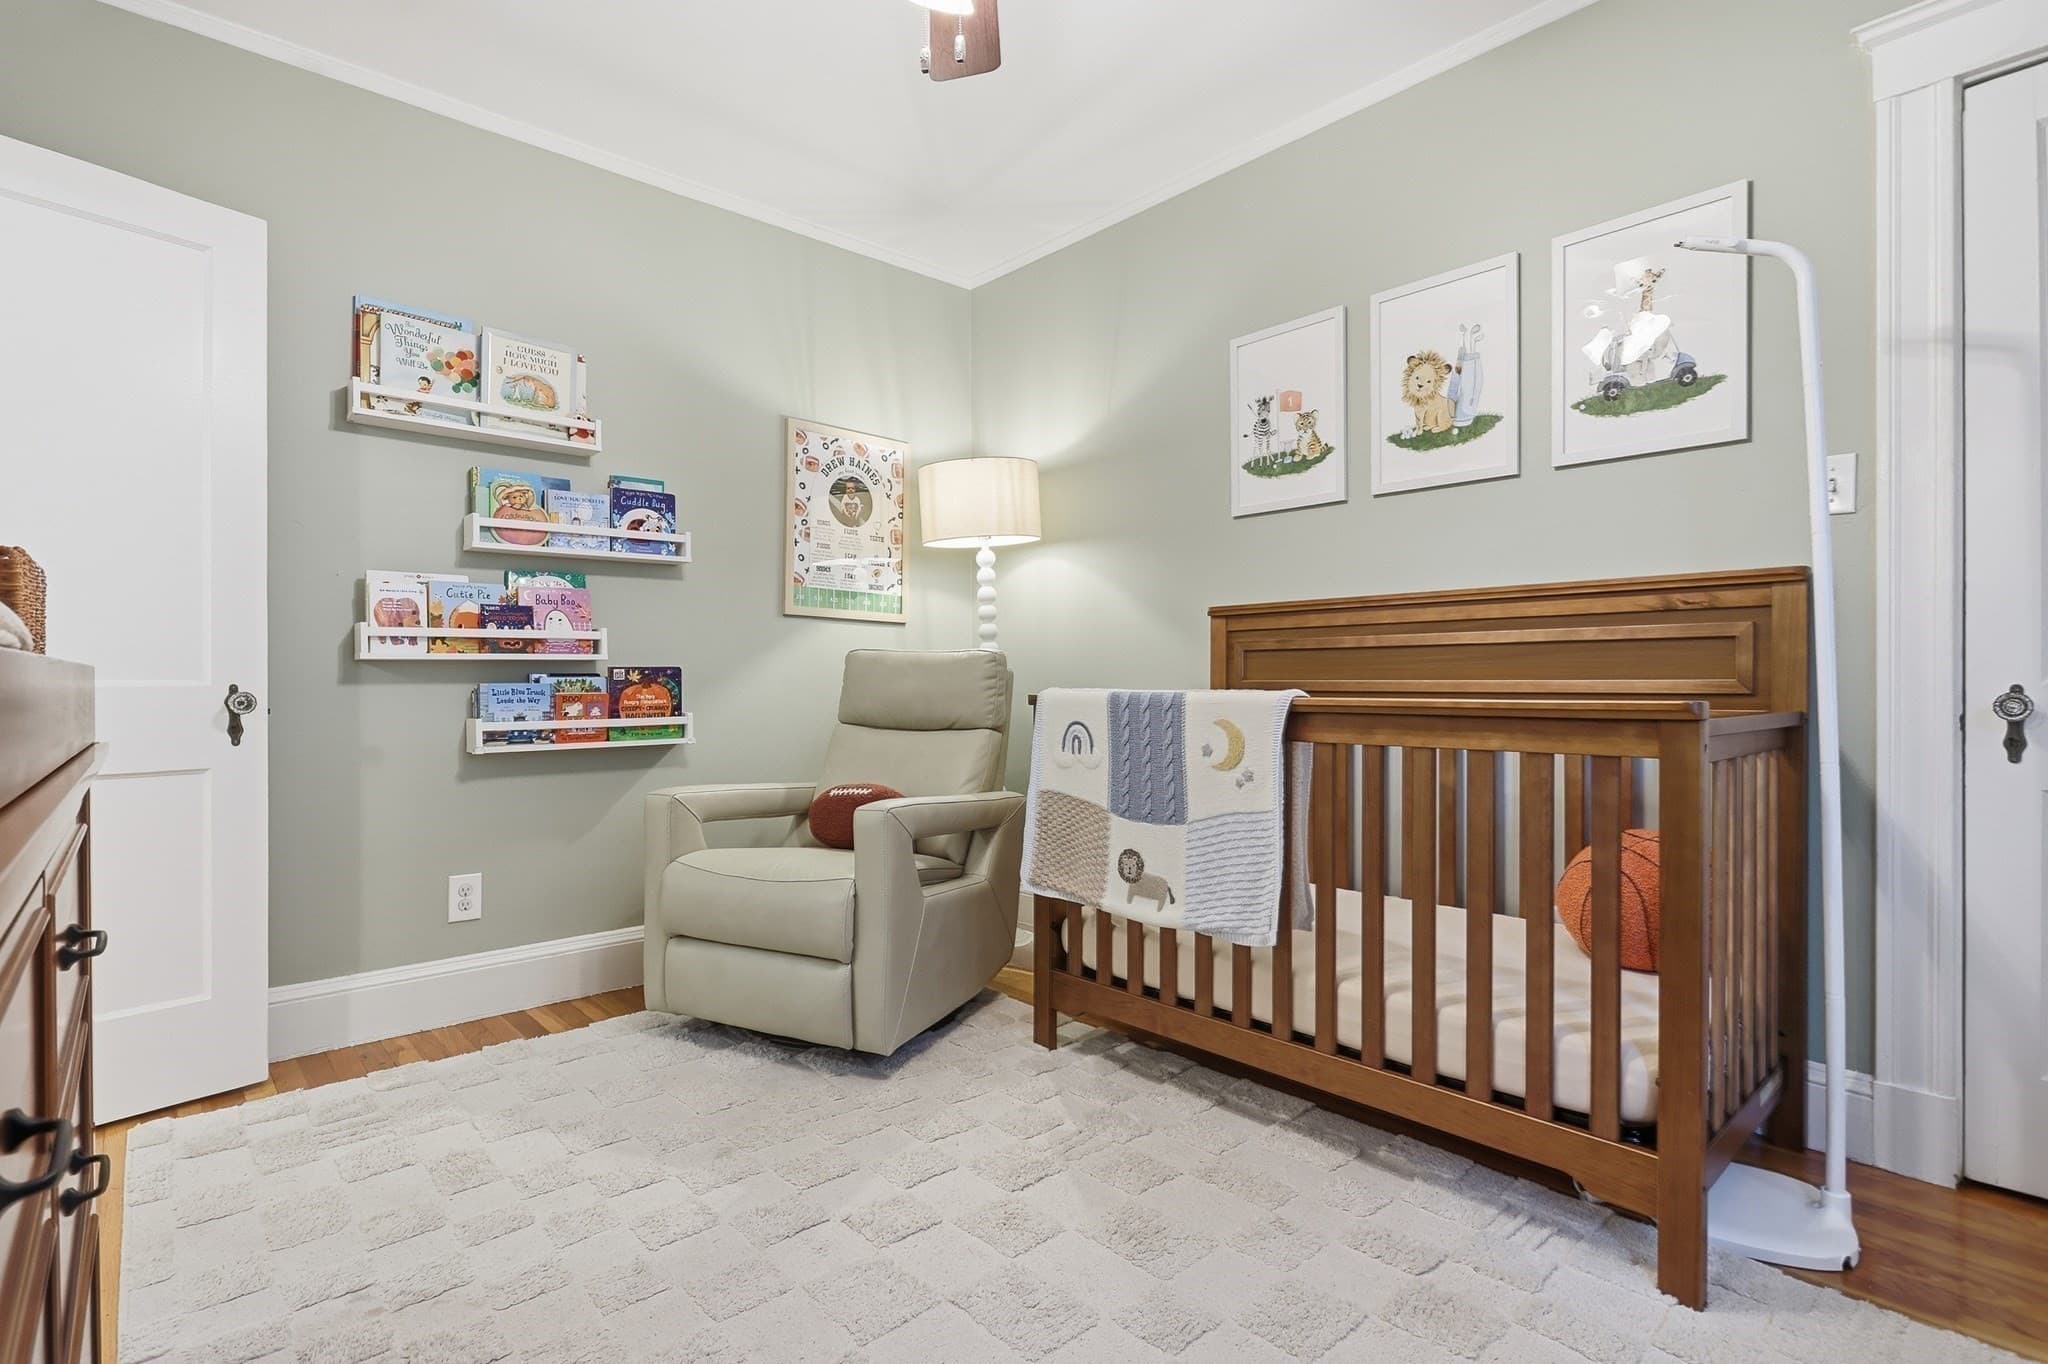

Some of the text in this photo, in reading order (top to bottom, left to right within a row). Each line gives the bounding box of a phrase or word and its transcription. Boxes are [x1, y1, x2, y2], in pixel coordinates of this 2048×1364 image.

[384, 322, 441, 345] Wonderful
[394, 335, 428, 352] Things
[504, 350, 557, 368] HOW MUCH
[516, 345, 546, 358] GUESS
[396, 357, 415, 368] Will
[510, 359, 537, 371] LOVE
[538, 365, 559, 375] YOU
[1287, 396, 1293, 407] 1
[820, 456, 846, 477] DREW
[849, 457, 881, 486] HAINES
[620, 496, 649, 507] Cuddle
[651, 498, 666, 514] Bug
[446, 587, 491, 600] Cutie Pie
[535, 594, 576, 609] Baby Boo
[491, 687, 546, 697] Little Blue Truck
[496, 697, 515, 705] Leads
[527, 697, 542, 705] Way
